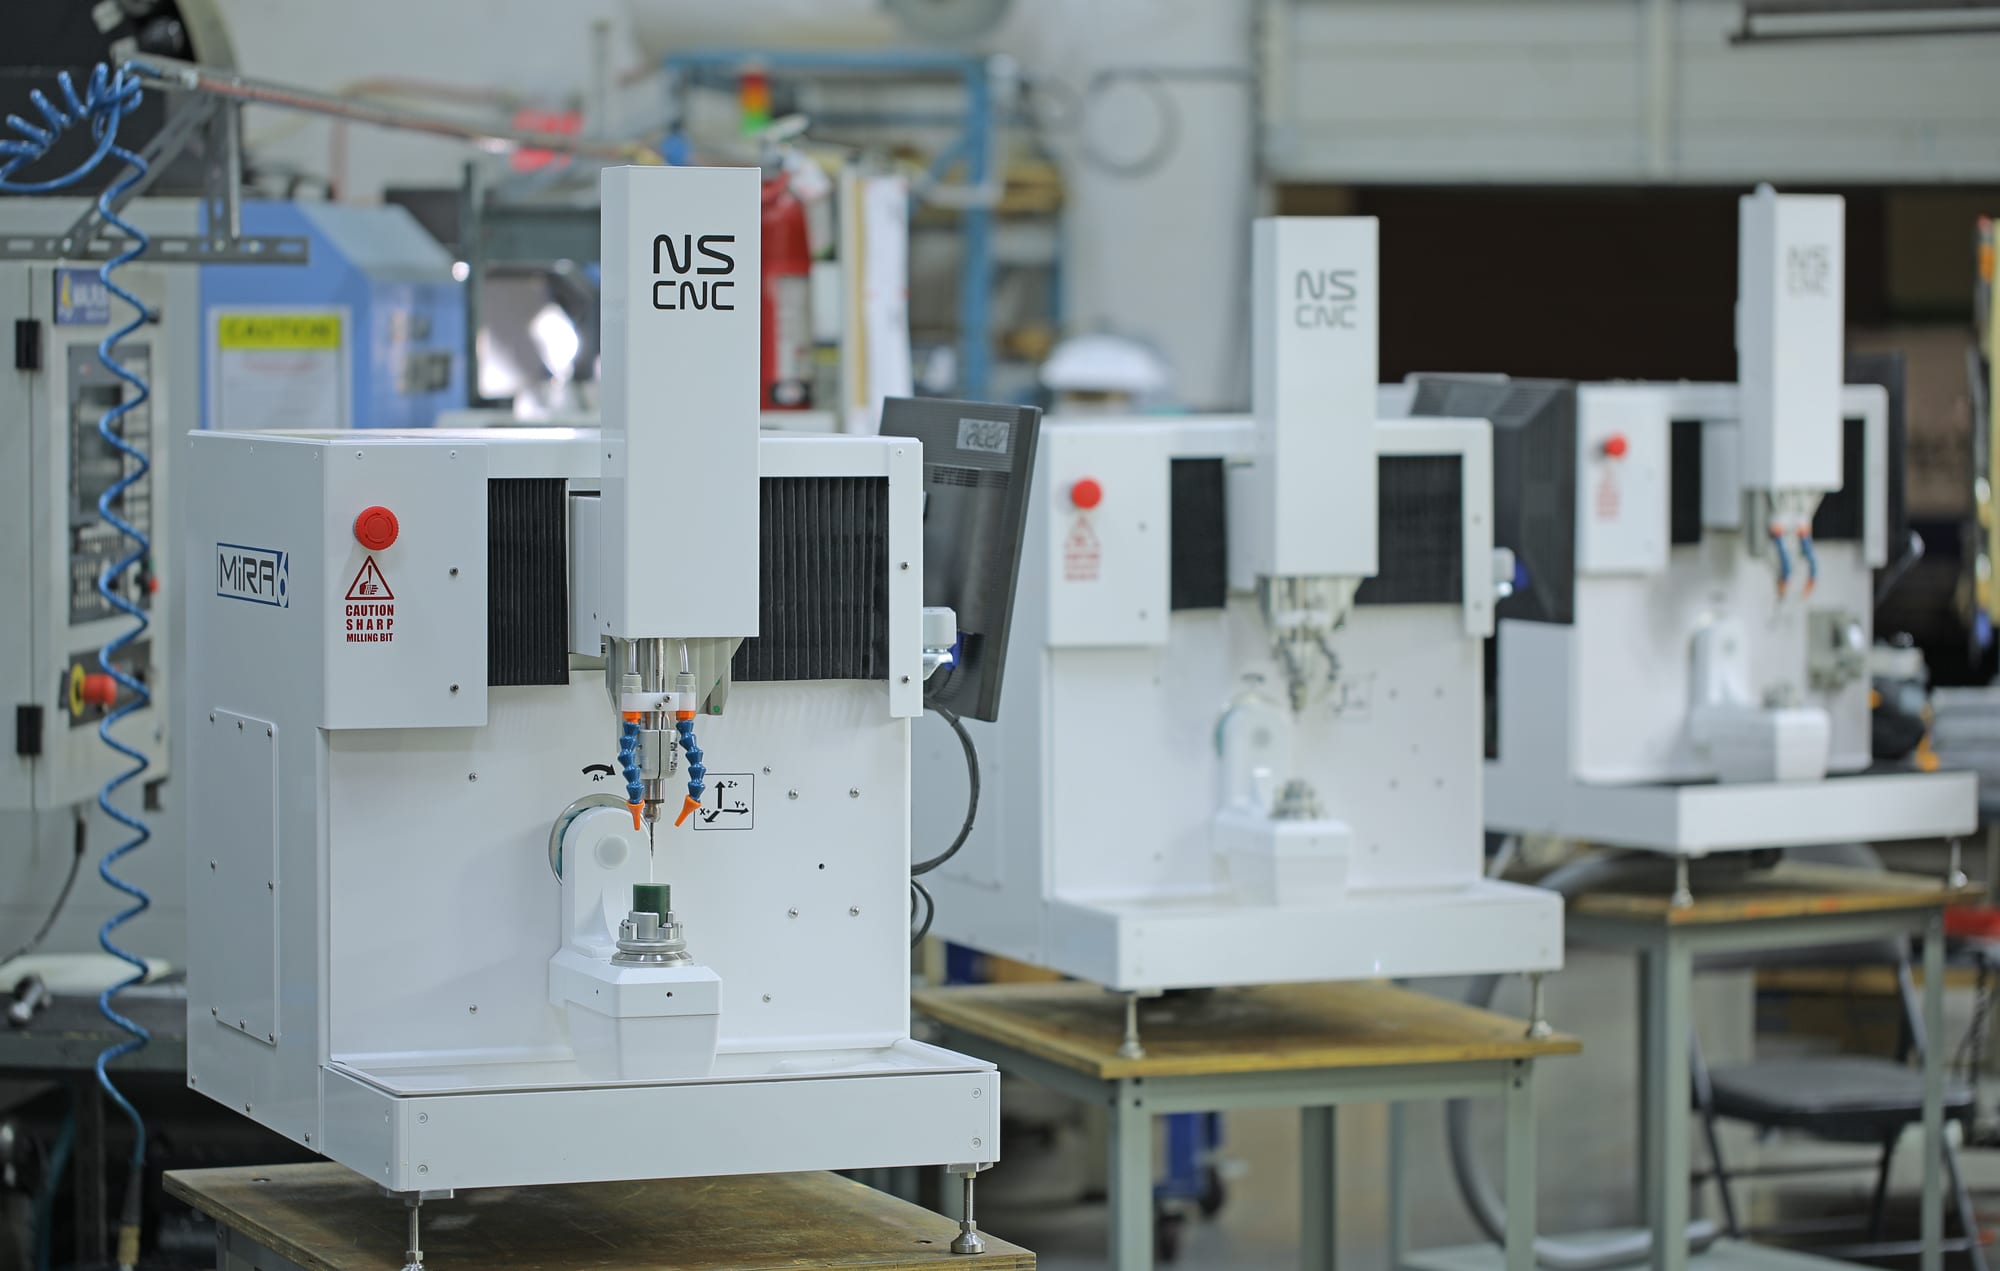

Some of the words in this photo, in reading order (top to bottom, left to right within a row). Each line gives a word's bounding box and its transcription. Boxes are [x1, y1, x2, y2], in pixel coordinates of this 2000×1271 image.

[653, 234, 735, 274] NS
[1296, 269, 1357, 301] NS
[653, 281, 735, 310] CNC
[1296, 304, 1357, 328] CNC
[345, 604, 394, 616] CAUTION
[346, 618, 394, 631] SHARP
[346, 633, 378, 642] MILLING
[380, 632, 394, 642] BIT
[592, 774, 605, 782] A+
[727, 780, 739, 788] Z+
[734, 801, 746, 809] Y+
[699, 808, 711, 816] X+
